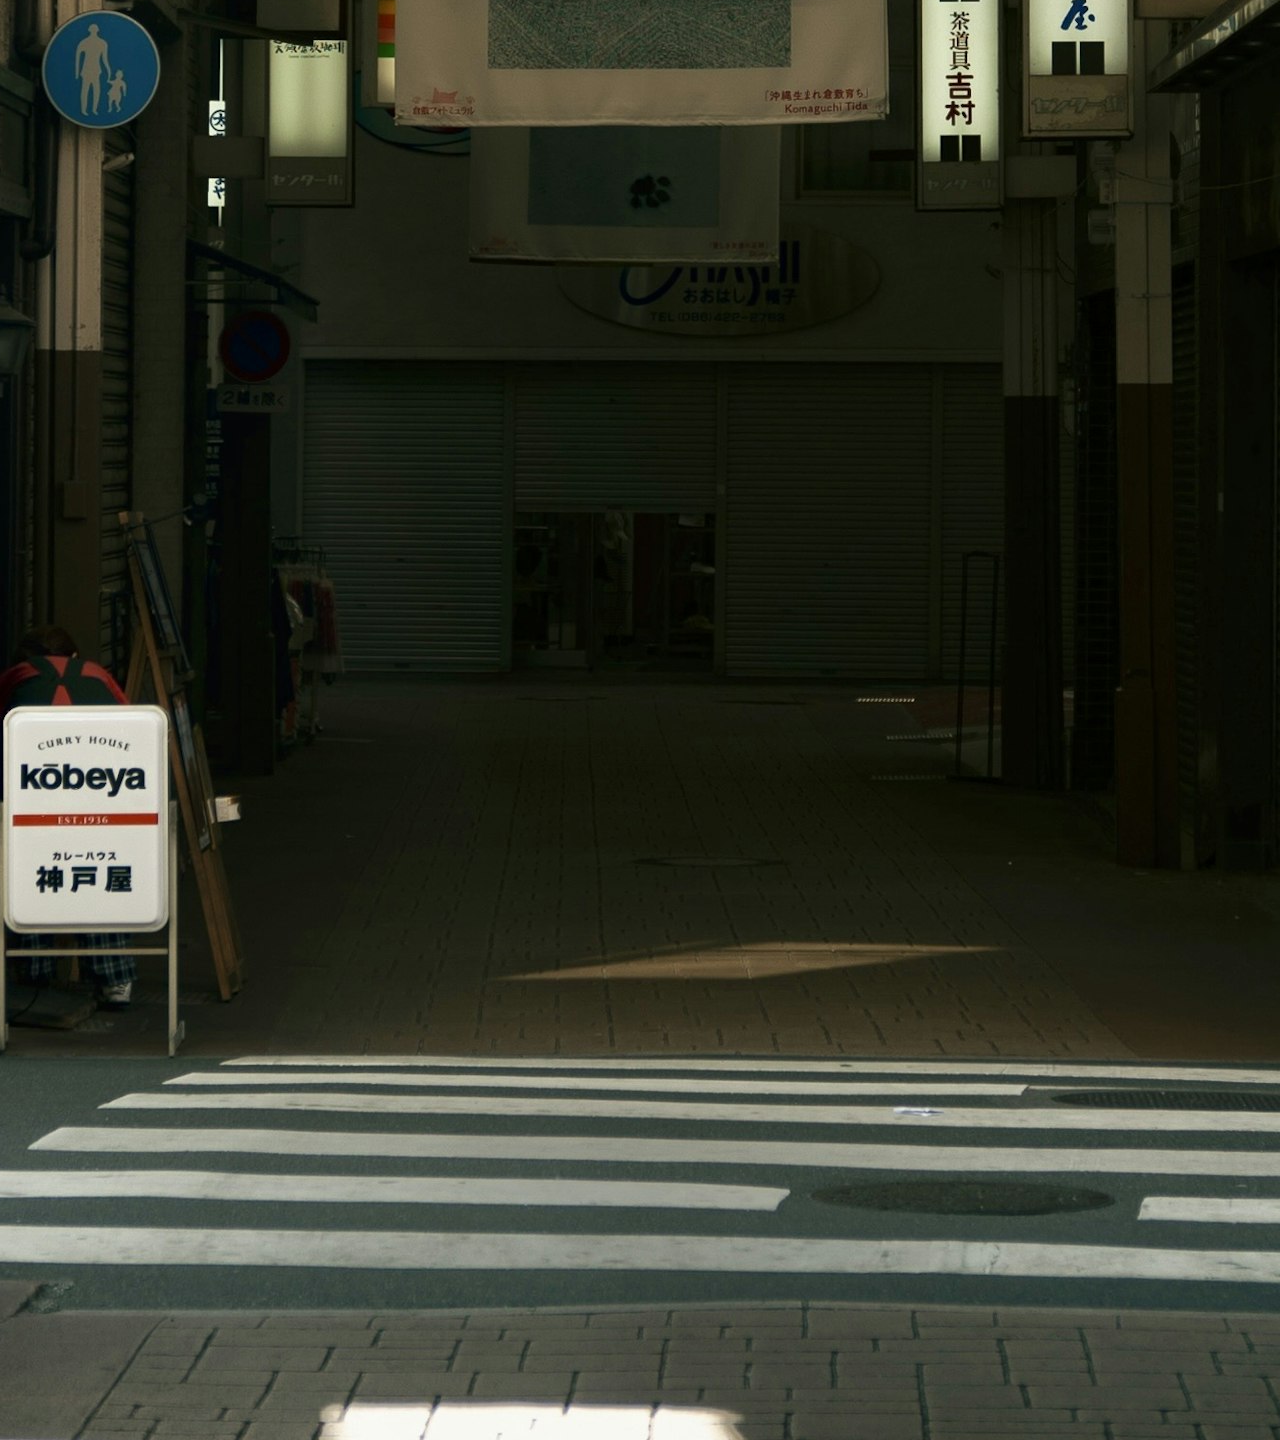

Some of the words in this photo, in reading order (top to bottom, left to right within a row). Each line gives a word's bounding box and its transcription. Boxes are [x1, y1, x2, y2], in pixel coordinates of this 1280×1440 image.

[784, 102, 842, 116] Komaguchi
[845, 100, 869, 112] Tida
[37, 735, 83, 752] CURRY
[88, 735, 132, 752] HOUSE
[19, 762, 147, 798] kōbeya
[57, 815, 110, 826] EST.1936
[52, 851, 117, 862] カレーハウス
[35, 864, 133, 894] 神戸屋
